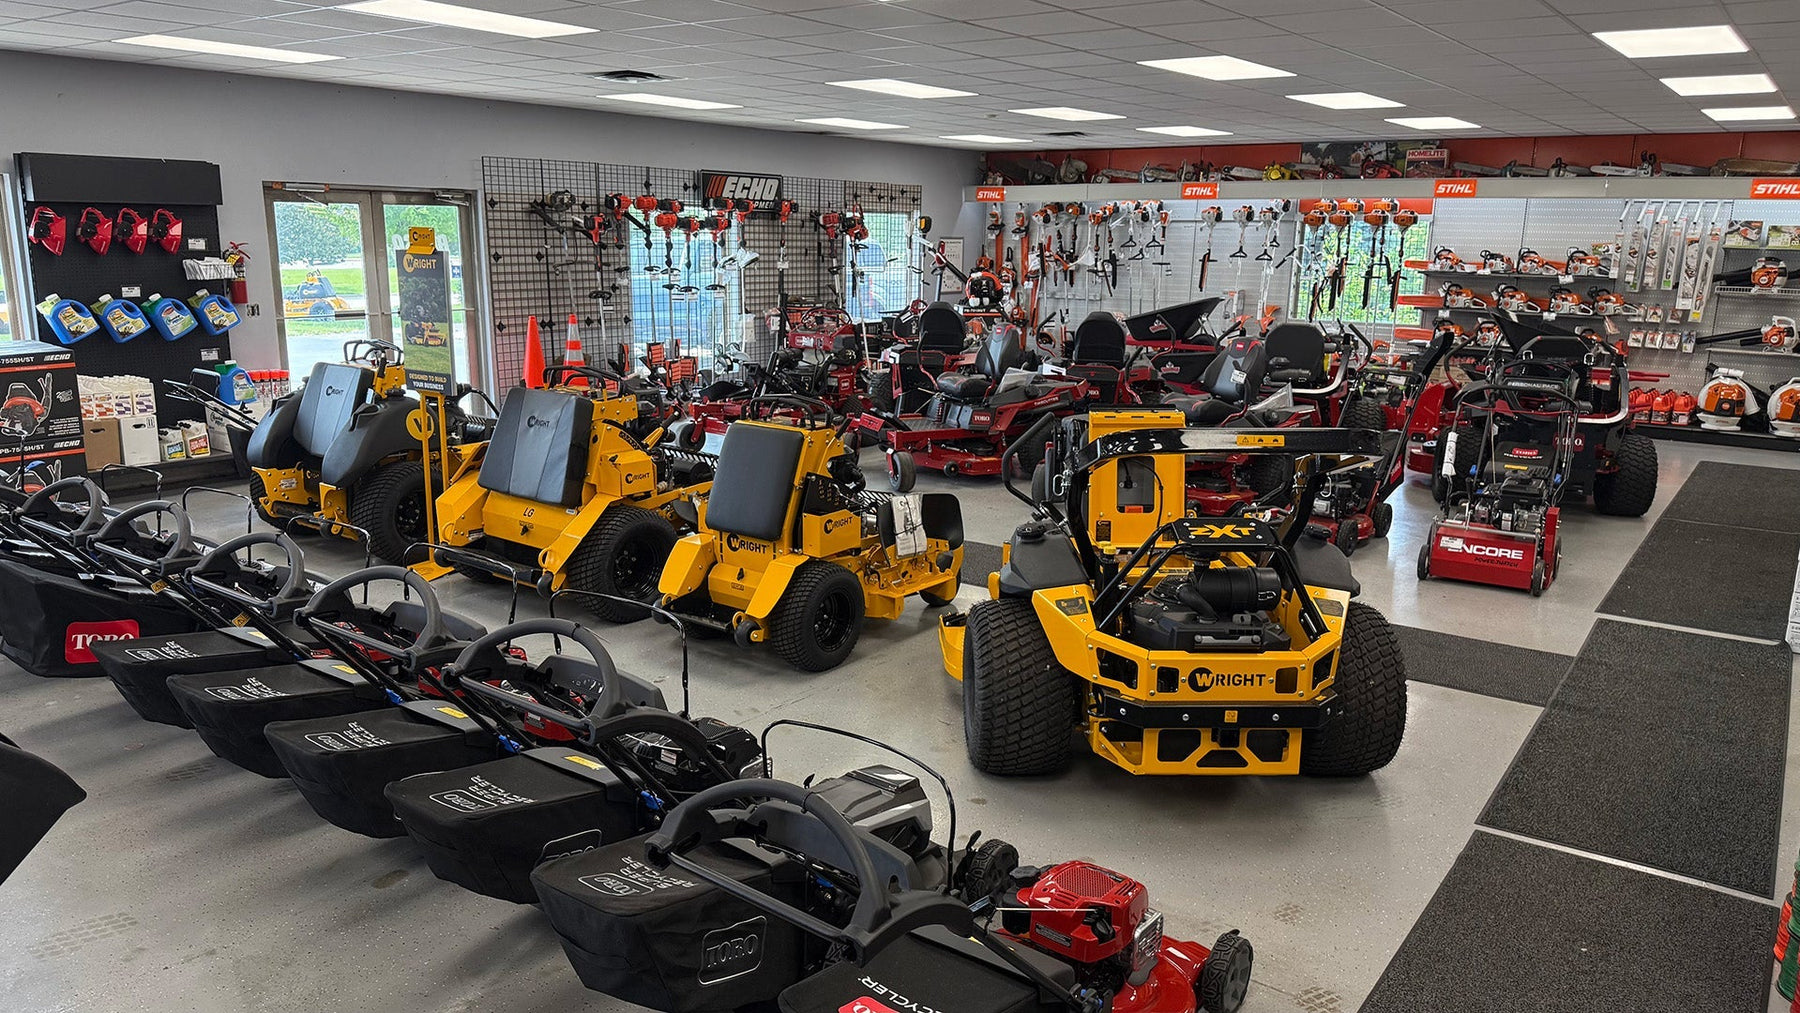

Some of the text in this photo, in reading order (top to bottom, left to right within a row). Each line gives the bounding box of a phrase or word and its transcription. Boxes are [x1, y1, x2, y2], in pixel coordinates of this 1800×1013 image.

[722, 176, 779, 201] ECHO
[977, 190, 1000, 199] STIHL
[1184, 187, 1213, 196] STIHL
[1436, 184, 1473, 194] STIHL
[1754, 184, 1800, 195] STIHL
[403, 253, 437, 273] WRIGHT
[50, 353, 71, 361] ECHO
[60, 440, 81, 448] ECHO
[625, 472, 650, 484] WRIGHT
[523, 507, 535, 518] LG
[823, 516, 853, 534] WRIGHT
[726, 532, 767, 554] WRIGHT
[1447, 544, 1524, 560] NCORE
[1187, 667, 1267, 693] WRIGHT
[593, 876, 640, 896] TORO
[705, 934, 758, 968] TORO
